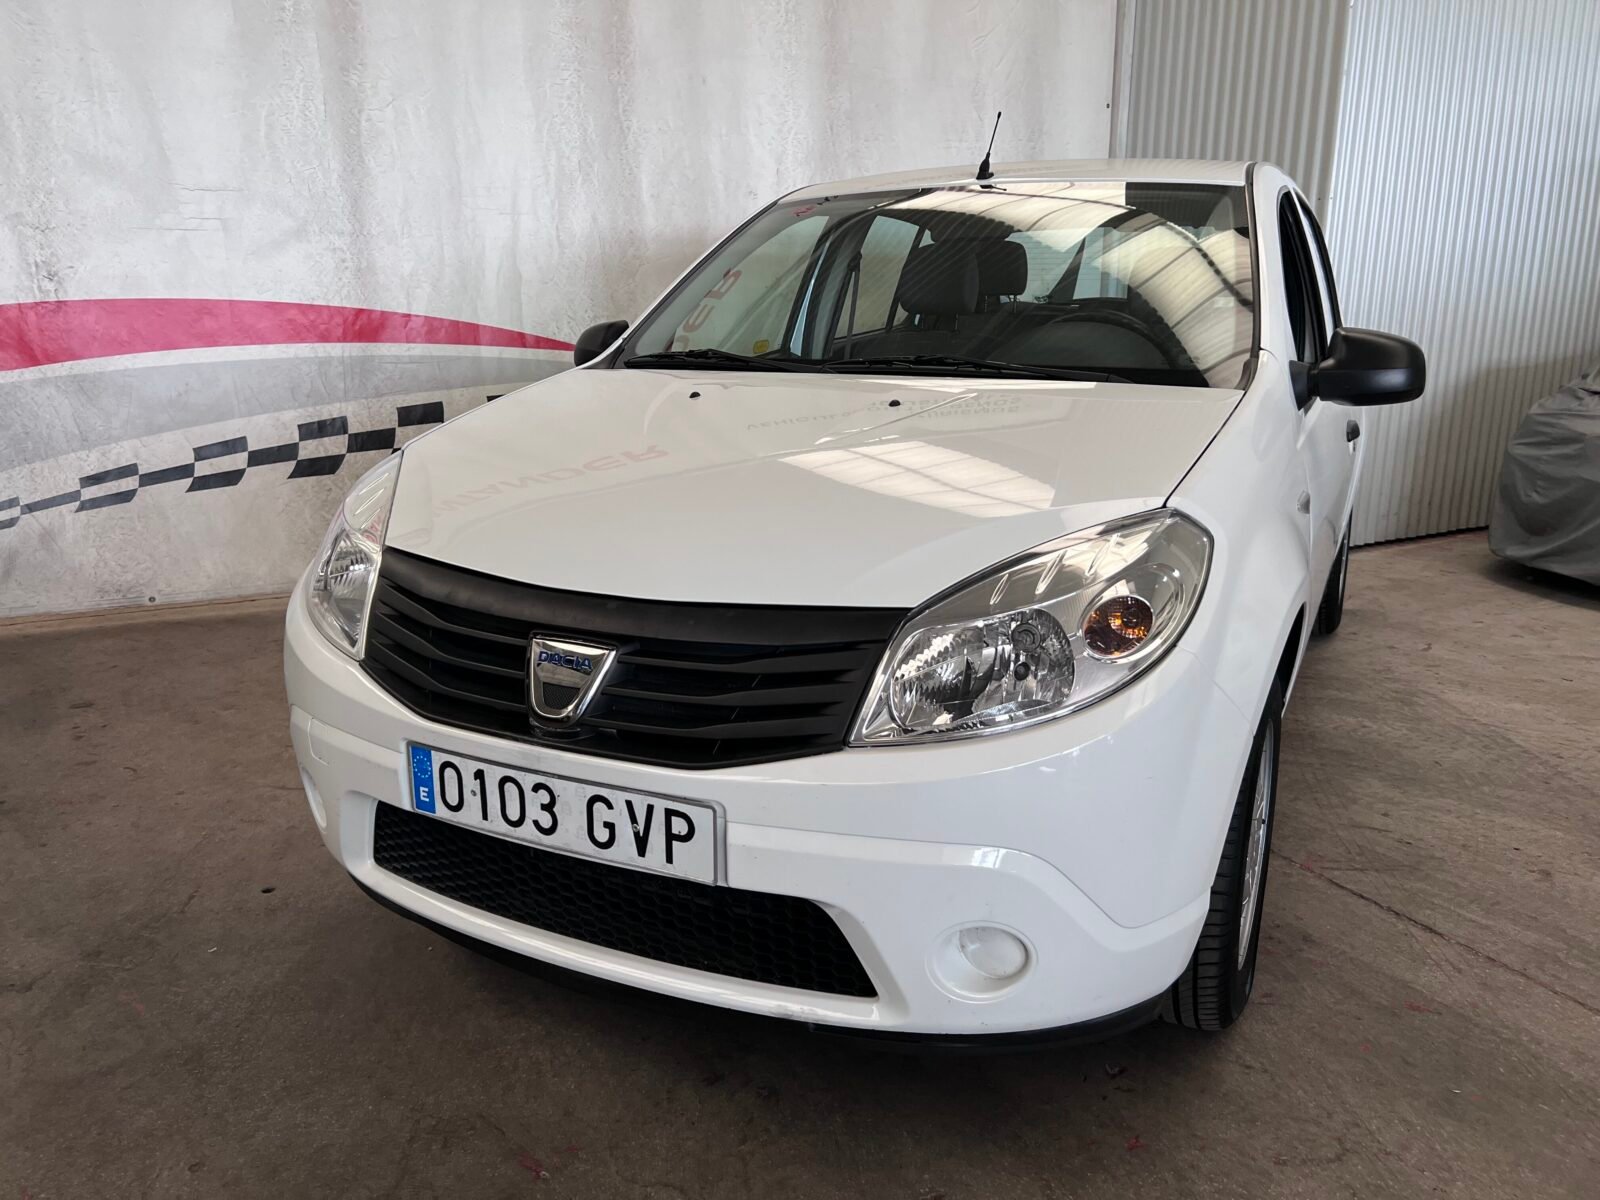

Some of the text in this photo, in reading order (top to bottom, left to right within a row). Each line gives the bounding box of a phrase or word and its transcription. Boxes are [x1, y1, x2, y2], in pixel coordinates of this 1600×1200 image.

[538, 650, 593, 670] DACIA
[419, 786, 430, 802] E
[438, 760, 696, 865] 0103 GVP
